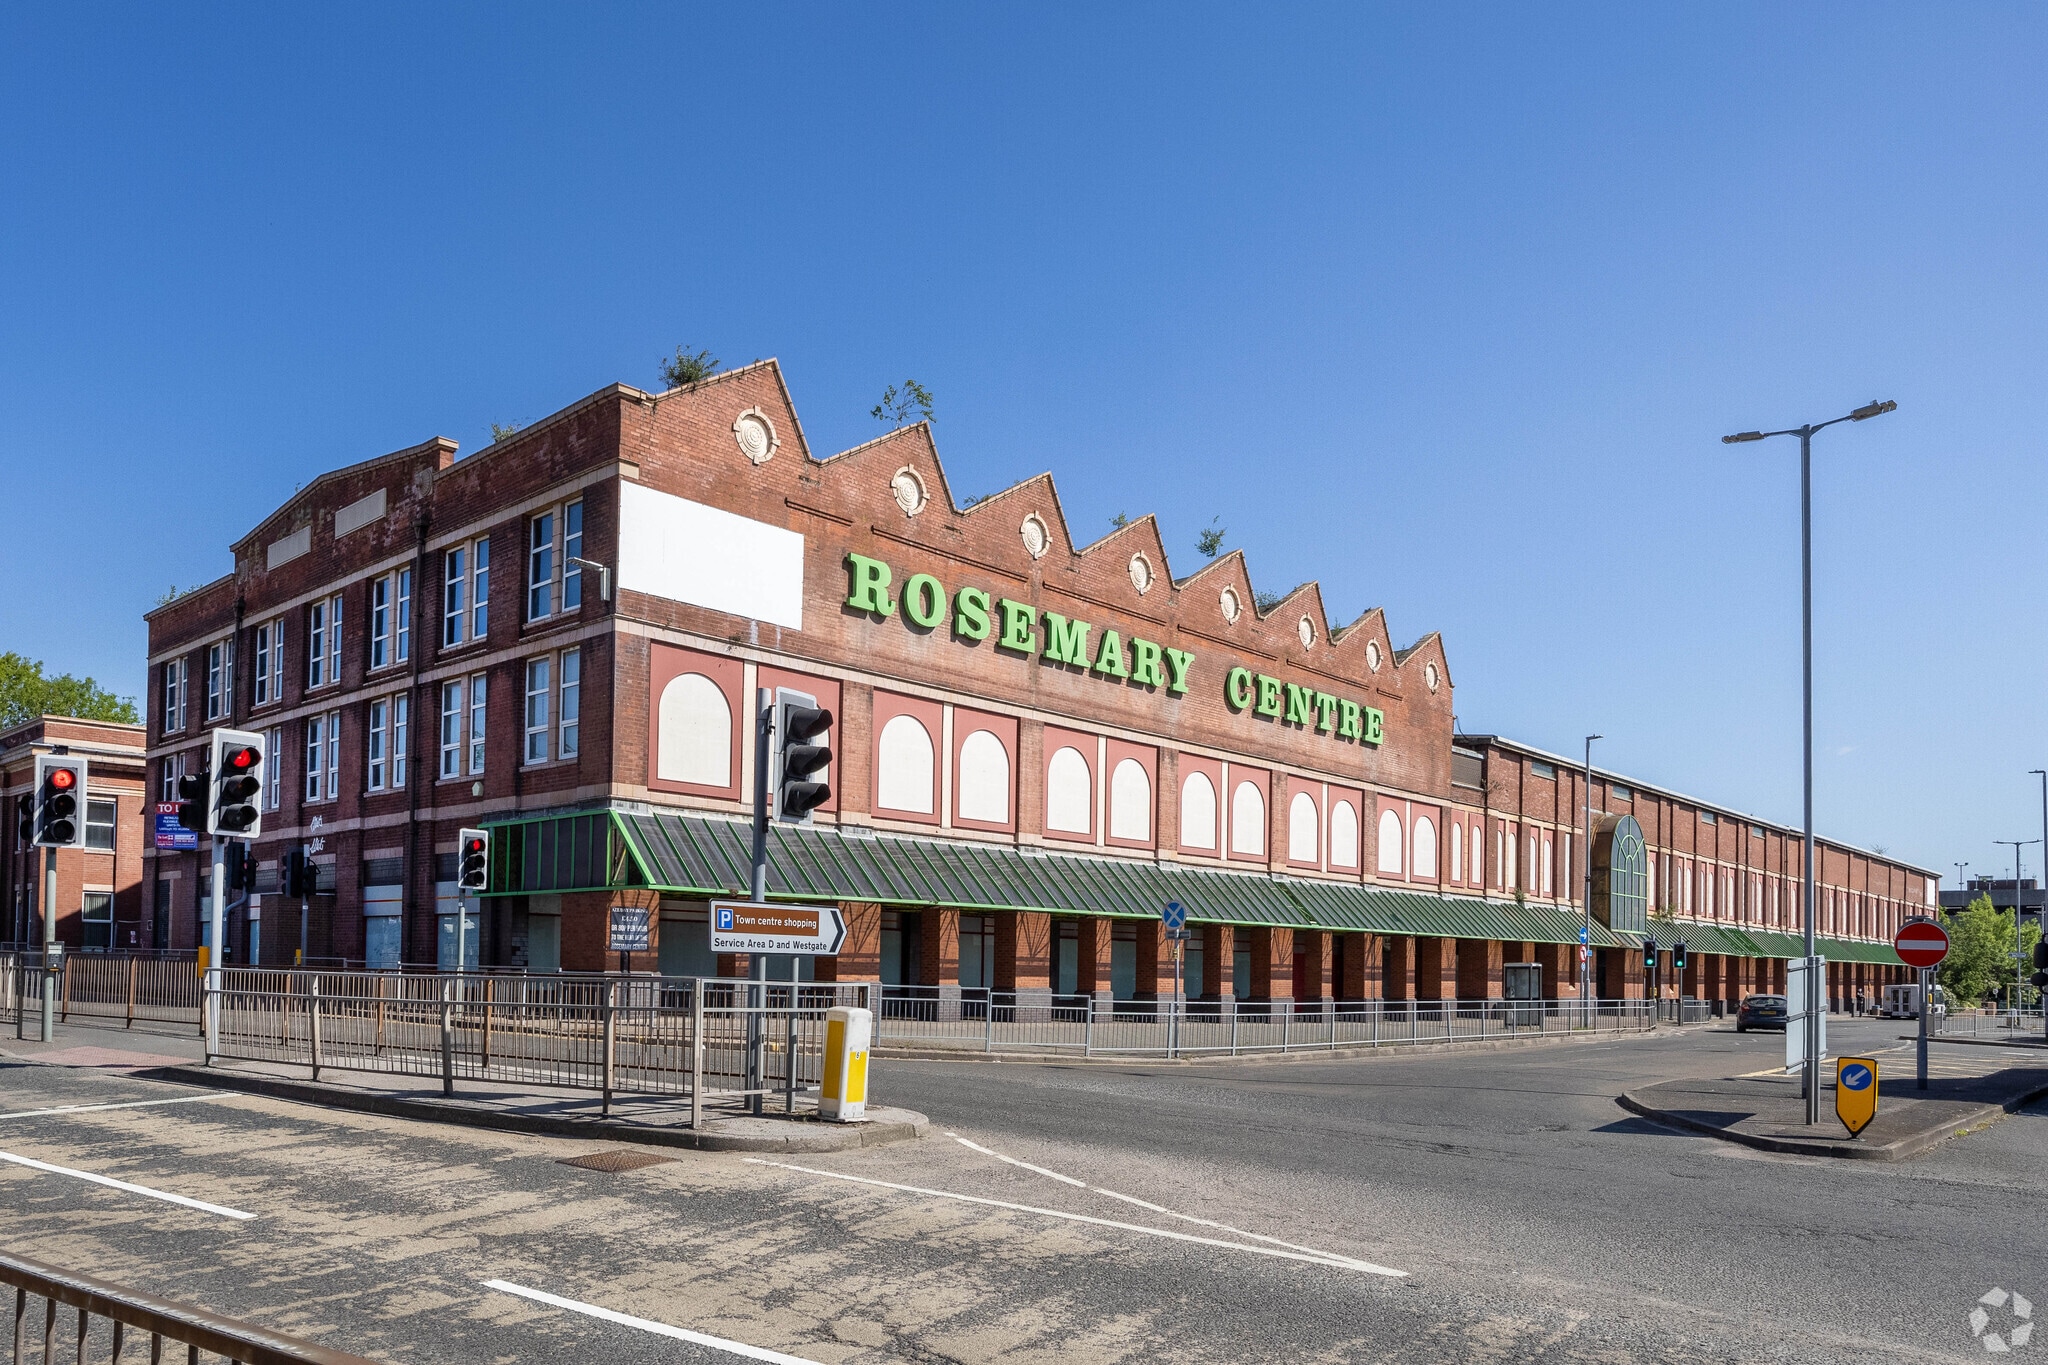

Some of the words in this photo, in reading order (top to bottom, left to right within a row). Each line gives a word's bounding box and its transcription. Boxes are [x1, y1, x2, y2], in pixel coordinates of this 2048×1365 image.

[846, 551, 1196, 695] ROSEMARY
[1225, 666, 1385, 746] CENTRE
[157, 804, 173, 813] TO
[720, 910, 731, 928] P
[735, 914, 756, 925] Town
[757, 916, 782, 926] centre
[784, 917, 817, 930] shopping
[714, 938, 745, 948] Service
[747, 939, 766, 948] Area
[769, 940, 774, 948] D
[776, 940, 790, 949] and
[793, 940, 828, 951] Westgate
